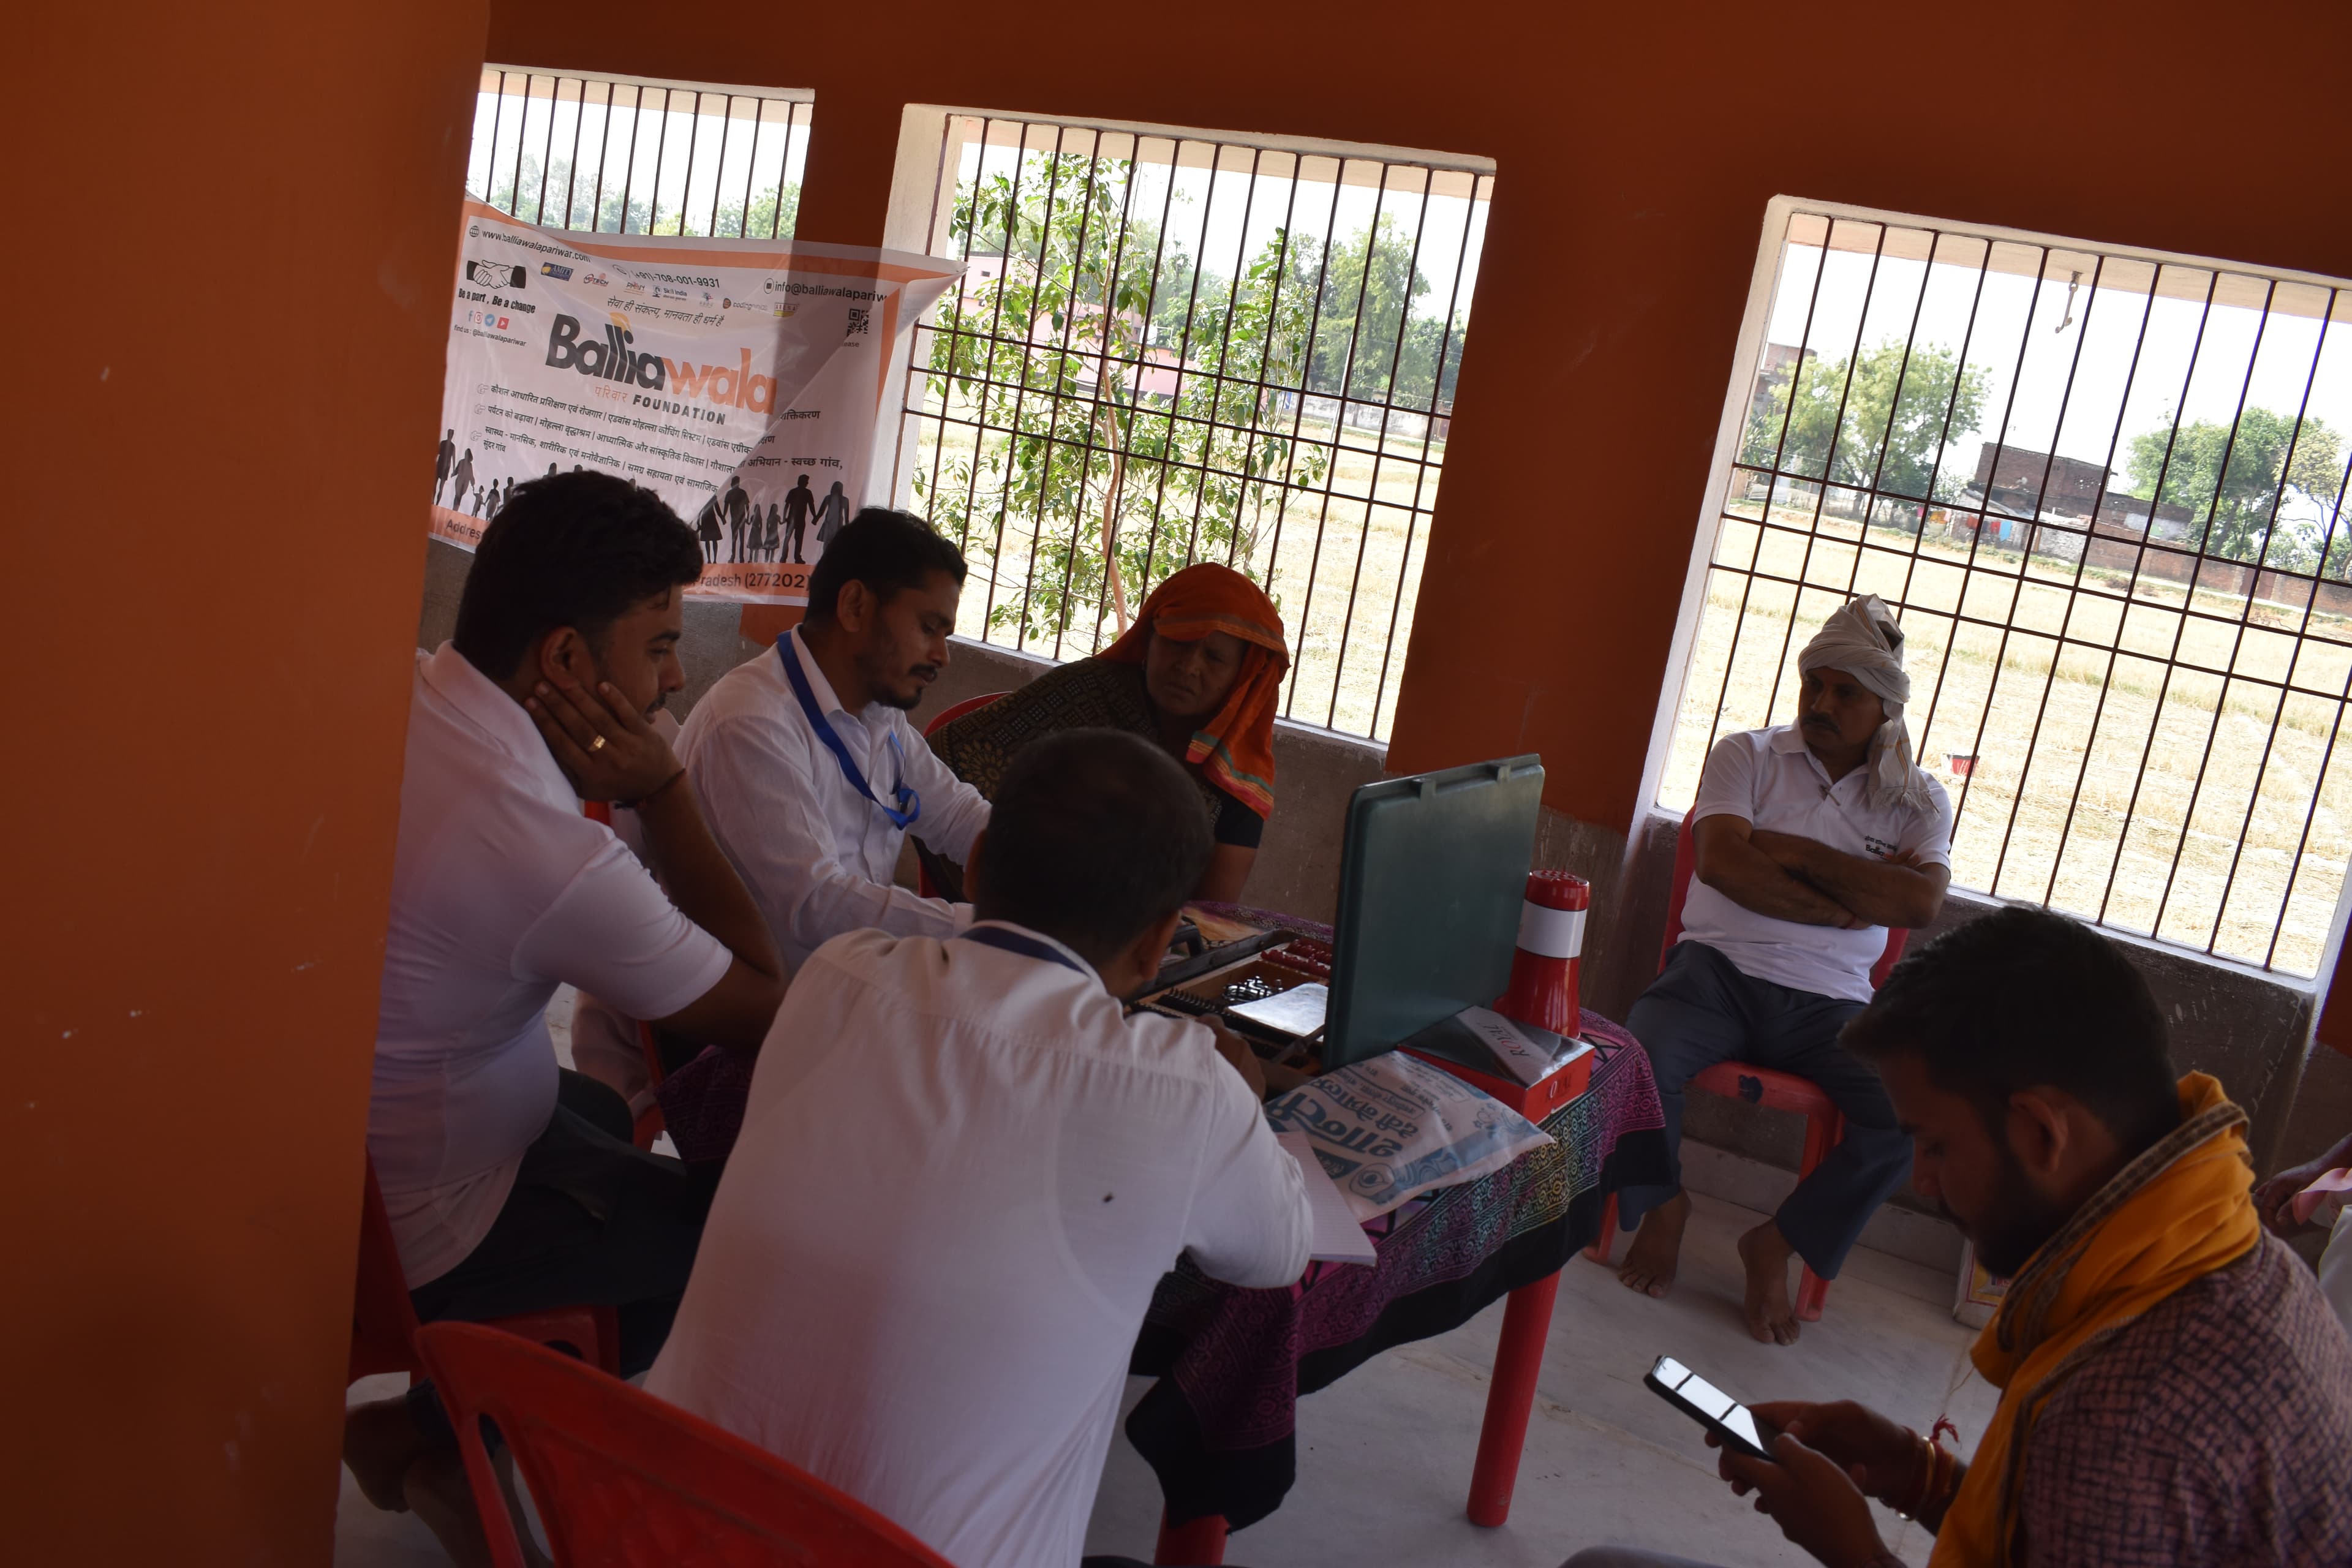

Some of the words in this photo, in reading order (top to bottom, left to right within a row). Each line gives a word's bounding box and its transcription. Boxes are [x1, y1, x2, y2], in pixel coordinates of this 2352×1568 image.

[482, 230, 591, 262] www.balliawalapariwar.com
[459, 288, 466, 298] Be
[471, 292, 486, 303] part
[492, 295, 502, 306] Be
[503, 298, 509, 307] a
[511, 300, 536, 314] change
[608, 295, 623, 308] सेवा
[624, 300, 634, 312] ही
[664, 309, 693, 322] मानवता
[693, 312, 703, 324] ही
[704, 314, 718, 326] धर्म
[716, 315, 725, 326] है
[545, 313, 777, 415] Balliawala
[510, 389, 539, 403] आधारित
[539, 395, 567, 411] प्रशिक्षण
[568, 404, 579, 415] एवं
[579, 405, 603, 419] रोजगार
[608, 412, 631, 426] एडवांस
[632, 418, 657, 432] मोहल्ला
[681, 428, 701, 443] सिस्टम
[706, 435, 729, 450] एडवांस
[633, 394, 726, 425] FOUNDATION
[483, 439, 495, 450] सुंदर
[495, 442, 506, 452] गांव
[505, 409, 513, 418] को
[540, 418, 564, 432] मोहल्ला
[565, 425, 591, 439] वृद्धाश्रम
[597, 432, 633, 449] आध्यात्मिक
[635, 442, 647, 453] और
[649, 445, 682, 461] सांस्कृतिक
[682, 452, 704, 467] विकास
[540, 440, 567, 454] शारीरिक
[569, 448, 580, 458] एवं
[581, 450, 620, 468] मनोवैज्ञानिक
[628, 462, 644, 475] समग्र
[646, 468, 673, 482] सहायता
[674, 474, 685, 485] एवं
[748, 456, 781, 468] अभियान
[791, 458, 816, 467] स्वच्छ
[446, 519, 482, 540] Addres
[1482, 1025, 1529, 1057] ROYAL
[1375, 1113, 1419, 1139] देवी
